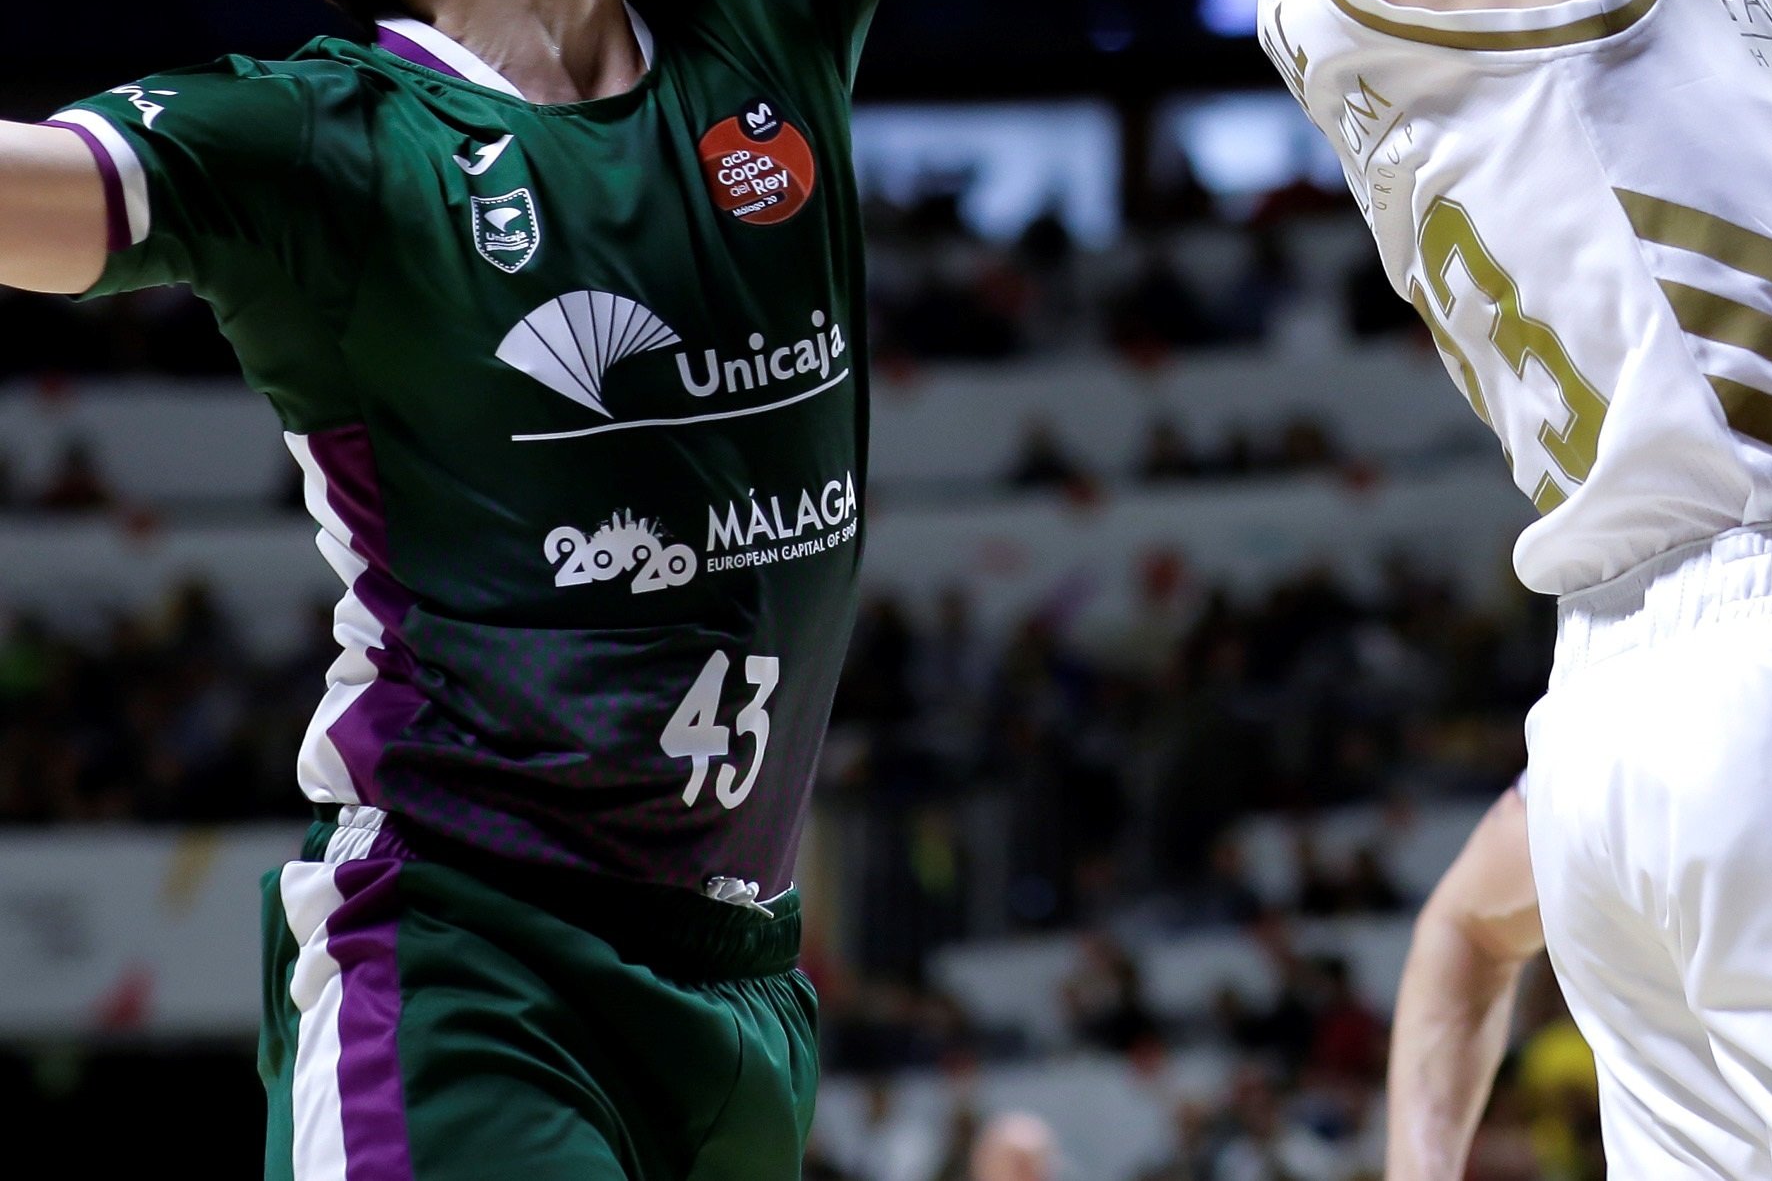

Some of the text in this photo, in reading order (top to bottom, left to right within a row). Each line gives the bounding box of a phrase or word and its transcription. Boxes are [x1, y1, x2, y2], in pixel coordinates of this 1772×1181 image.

[718, 156, 774, 185] Copa
[722, 150, 751, 167] acb
[730, 170, 788, 197] del Rey
[1374, 122, 1414, 211] GROUP
[675, 310, 846, 397] Unicaja
[706, 470, 857, 552] MÁLAGA
[544, 526, 697, 594] 2020
[707, 549, 779, 572] EUROPEAN
[781, 537, 826, 562] CAPITAL
[827, 531, 841, 548] OF
[659, 649, 780, 809] 43
